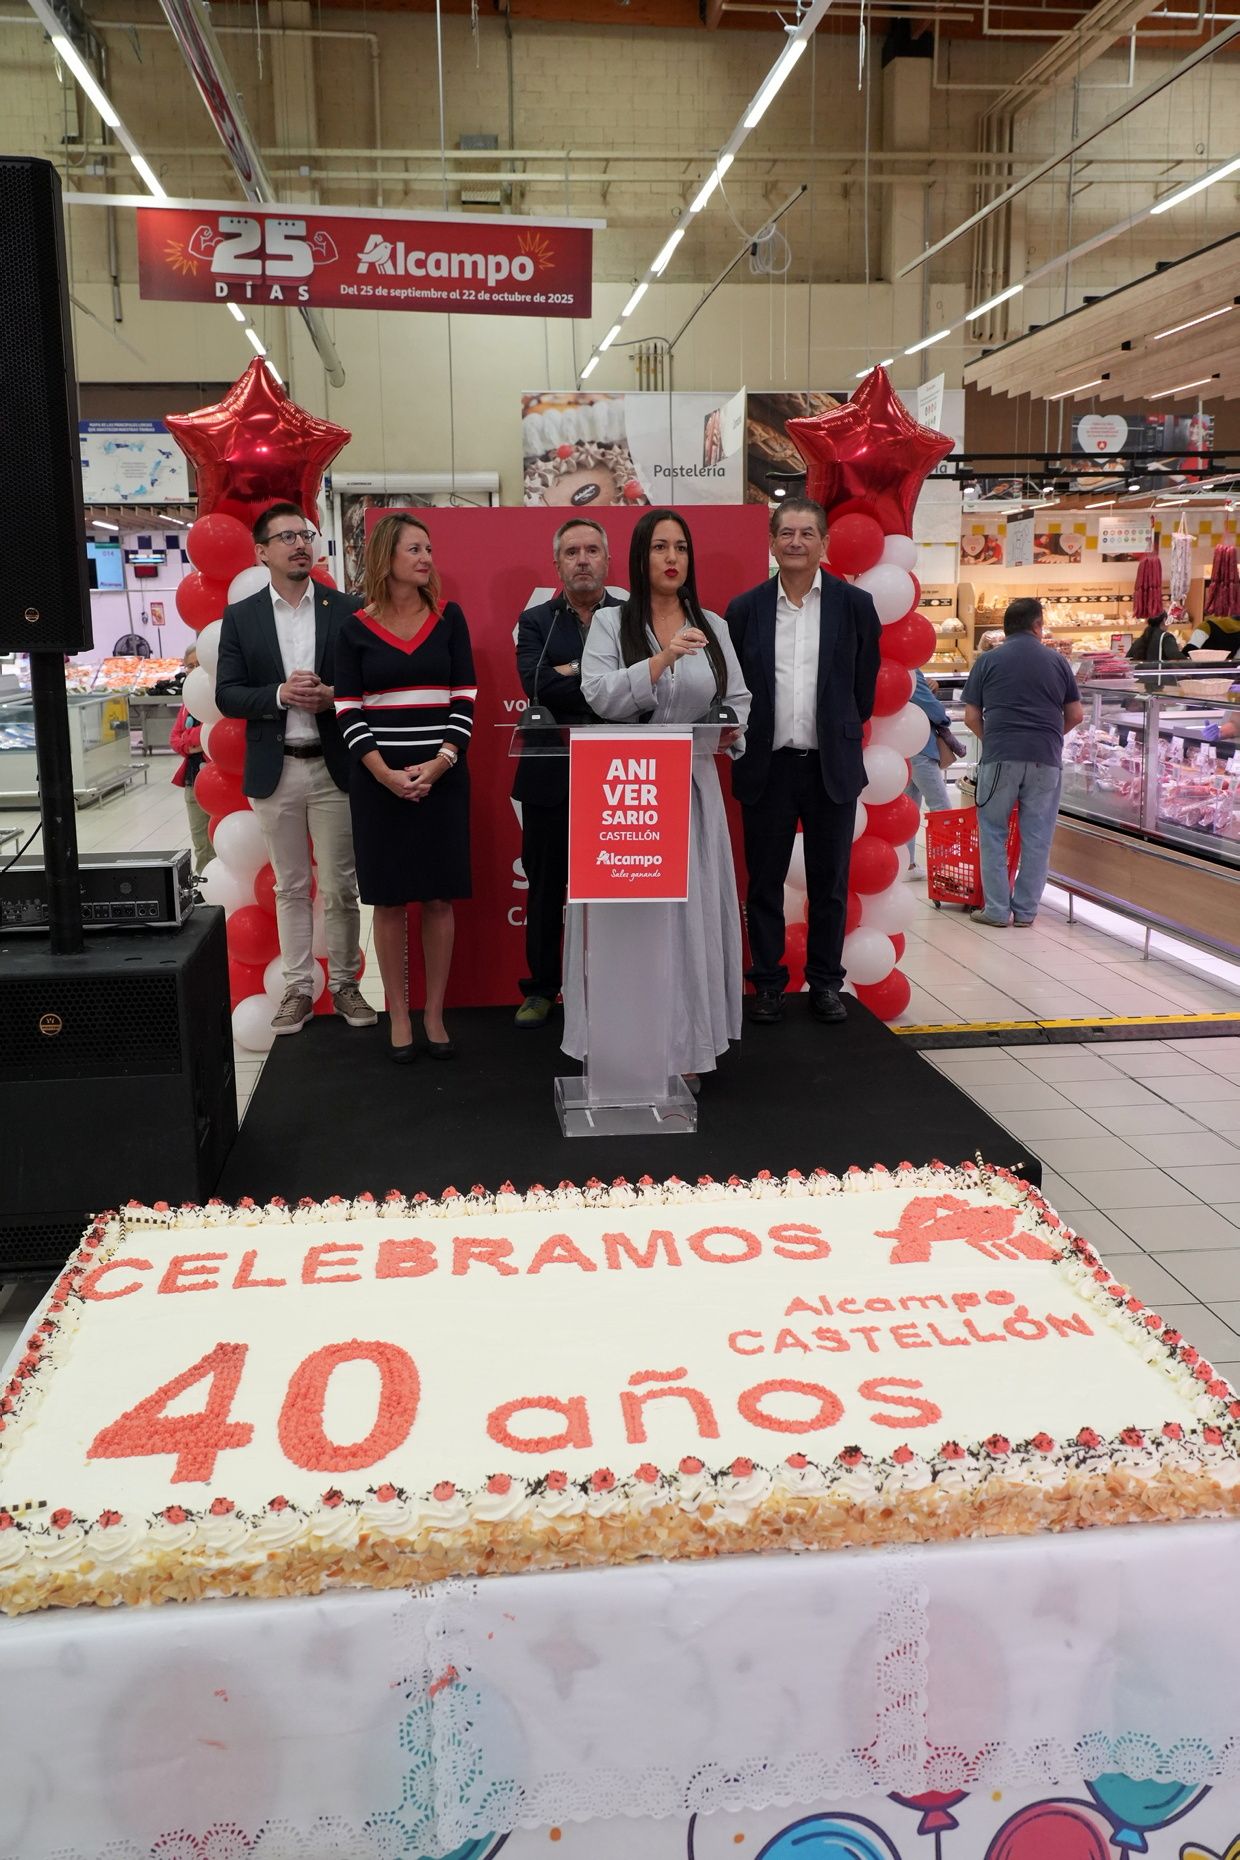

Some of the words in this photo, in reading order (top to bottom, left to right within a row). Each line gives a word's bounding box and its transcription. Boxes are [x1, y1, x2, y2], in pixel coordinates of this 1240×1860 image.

[210, 216, 314, 277] 25
[357, 234, 535, 286] Alcampo
[215, 281, 310, 301] DÍAS
[340, 285, 357, 295] Del
[360, 286, 373, 295] 25
[375, 286, 388, 296] de
[390, 287, 448, 299] septiembre
[449, 289, 461, 299] al
[463, 290, 476, 300] 22
[477, 290, 490, 301] de
[492, 291, 532, 302] octubre
[533, 292, 546, 303] de
[547, 294, 574, 304] 2025
[654, 464, 725, 477] Pastelería
[606, 759, 656, 780] ANI
[603, 784, 658, 806] VER
[602, 810, 658, 825] SARIO
[599, 829, 660, 841] CASTELLÓN
[596, 850, 662, 867] Alcampo
[630, 869, 661, 882] ganando
[80, 1222, 831, 1301] CELEBRAMOS
[785, 1289, 1015, 1317] Alcampo
[728, 1305, 1094, 1355] CASTELLÓN
[86, 1338, 421, 1485] 40
[487, 1366, 942, 1455] años
